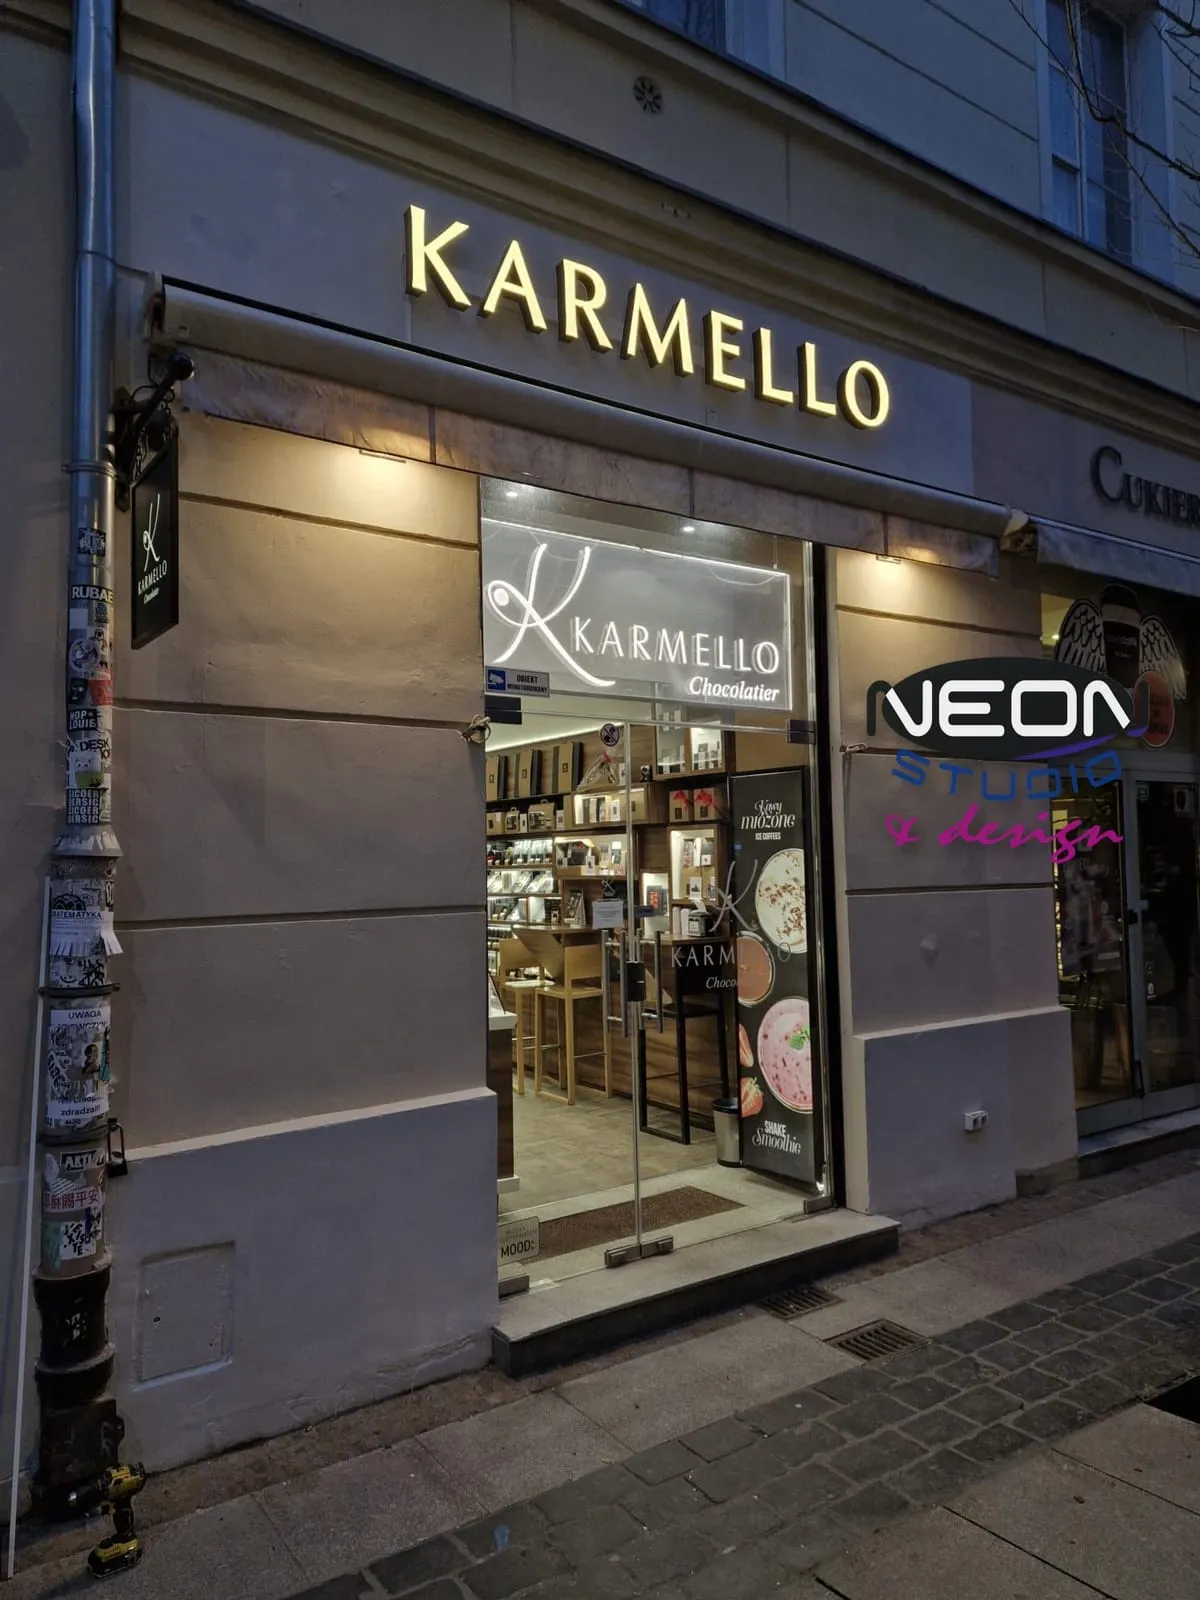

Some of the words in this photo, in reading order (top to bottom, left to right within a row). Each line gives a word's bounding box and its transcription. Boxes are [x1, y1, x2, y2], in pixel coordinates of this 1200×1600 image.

[404, 204, 891, 429] KARMELLO
[138, 559, 168, 596] KARMELLO
[572, 616, 780, 674] KARMELLO
[516, 674, 538, 683] OBIEKT
[689, 676, 780, 702] Chocolatier
[754, 800, 782, 816] Kawy
[68, 1010, 102, 1020] UWAGA
[752, 1127, 802, 1155] Smoothie
[764, 1119, 787, 1138] SHAKE
